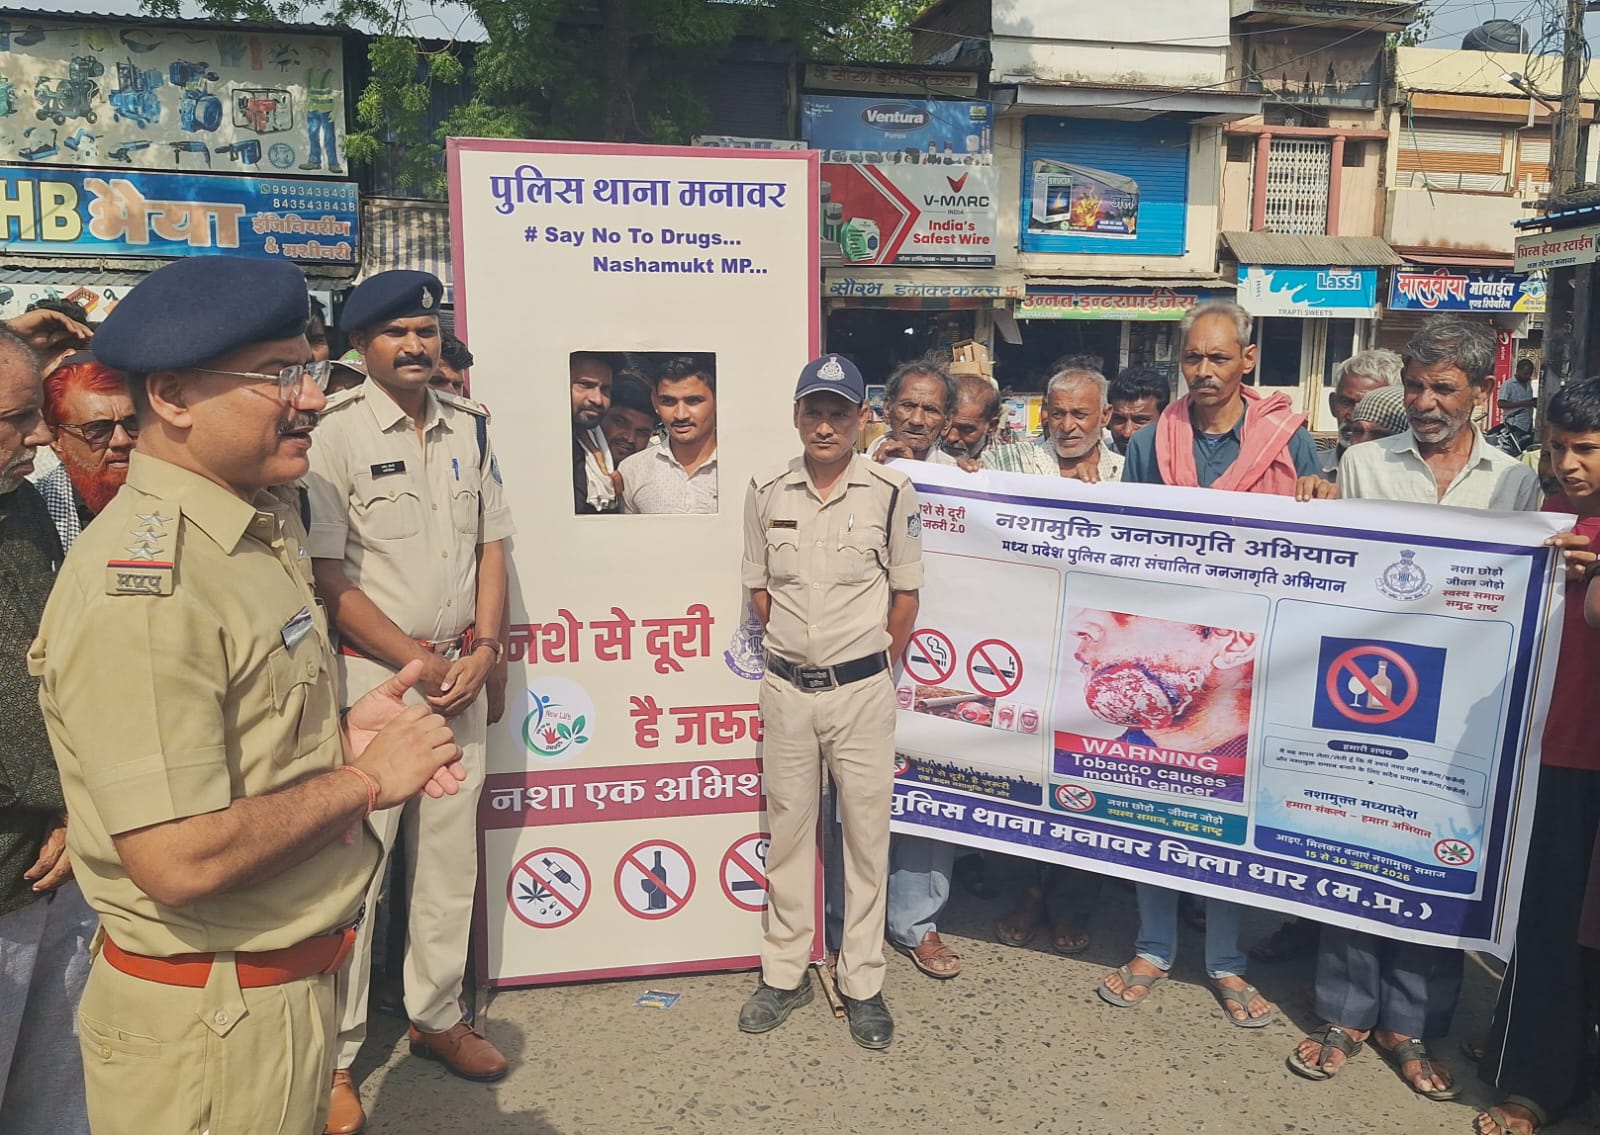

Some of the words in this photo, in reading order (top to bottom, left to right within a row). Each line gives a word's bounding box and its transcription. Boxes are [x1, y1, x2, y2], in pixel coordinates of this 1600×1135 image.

[867, 110, 924, 124] Ventura
[273, 185, 354, 198] 9993438438
[490, 165, 585, 214] पुलिस
[593, 179, 670, 206] थाना
[678, 181, 787, 208] मनावर
[924, 194, 989, 207] V-MARC
[84, 178, 245, 247] भैया
[273, 198, 355, 211] 8435438438
[929, 220, 975, 231] India's
[264, 236, 279, 253] &
[524, 226, 538, 243] #
[545, 227, 585, 246] Say
[592, 228, 621, 244] No
[628, 228, 654, 244] To
[661, 229, 741, 249] Drugs...
[914, 233, 955, 244] Safest
[959, 234, 989, 244] Wire
[1542, 240, 1561, 256] हेयर
[1563, 234, 1593, 251] स्टाईल
[593, 256, 714, 273] Nashamukt
[721, 258, 768, 274] MP...
[1317, 273, 1361, 290] Lassi
[1024, 294, 1073, 308] उन्नत
[918, 502, 932, 515] शे
[935, 503, 945, 517] से
[947, 506, 966, 522] दूरी
[996, 512, 1103, 541] नशामुक्ति
[1110, 524, 1235, 556] जनजागृति
[1243, 538, 1359, 567] अभियान
[1001, 540, 1027, 554] मध्य
[1031, 541, 1064, 559] प्रदेश
[1067, 545, 1106, 565] पुलिस
[1109, 552, 1139, 570] द्वारा
[1144, 553, 1201, 575] संचालित
[1204, 563, 1277, 588] जनजागृति
[1282, 571, 1346, 594] अभियान
[1450, 564, 1474, 575] नशा
[1445, 576, 1477, 587] जीवन
[1442, 589, 1470, 597] स्वस्थ
[1473, 591, 1505, 602] समाज
[507, 608, 584, 665] नशे
[589, 607, 636, 662] से
[641, 603, 715, 675] दूरी
[630, 695, 664, 749] है
[669, 703, 764, 745] जरू
[1081, 738, 1219, 771] WARNING
[1071, 753, 1152, 775] Tobacco
[1157, 766, 1227, 788] causes
[490, 783, 577, 812] नशा
[584, 780, 647, 810] एक
[655, 765, 766, 802] अभिश
[1083, 768, 1143, 786] mouth
[1148, 780, 1214, 797] cancer
[1107, 799, 1129, 808] नशा
[1167, 808, 1198, 820] जीवन
[1285, 800, 1312, 811] हमारा
[1315, 803, 1347, 818] संकल्प
[1361, 815, 1388, 827] हमारा
[1392, 820, 1432, 839] अभियान
[1361, 797, 1418, 820] मध्यप्रदेश
[890, 790, 967, 821] पुलिस
[972, 802, 1042, 838] थाना
[1049, 817, 1151, 861] मनावर
[1159, 841, 1241, 878] जिला
[1248, 861, 1307, 892] धार
[1315, 877, 1434, 921] (म.प्र.)
[1304, 850, 1315, 859] 15
[1320, 852, 1330, 862] से
[1333, 854, 1347, 864] 30
[1349, 860, 1379, 874] जुलाई
[1381, 868, 1411, 882] 2026
[1306, 838, 1341, 853] मिलकर
[1414, 866, 1447, 879] समाज
